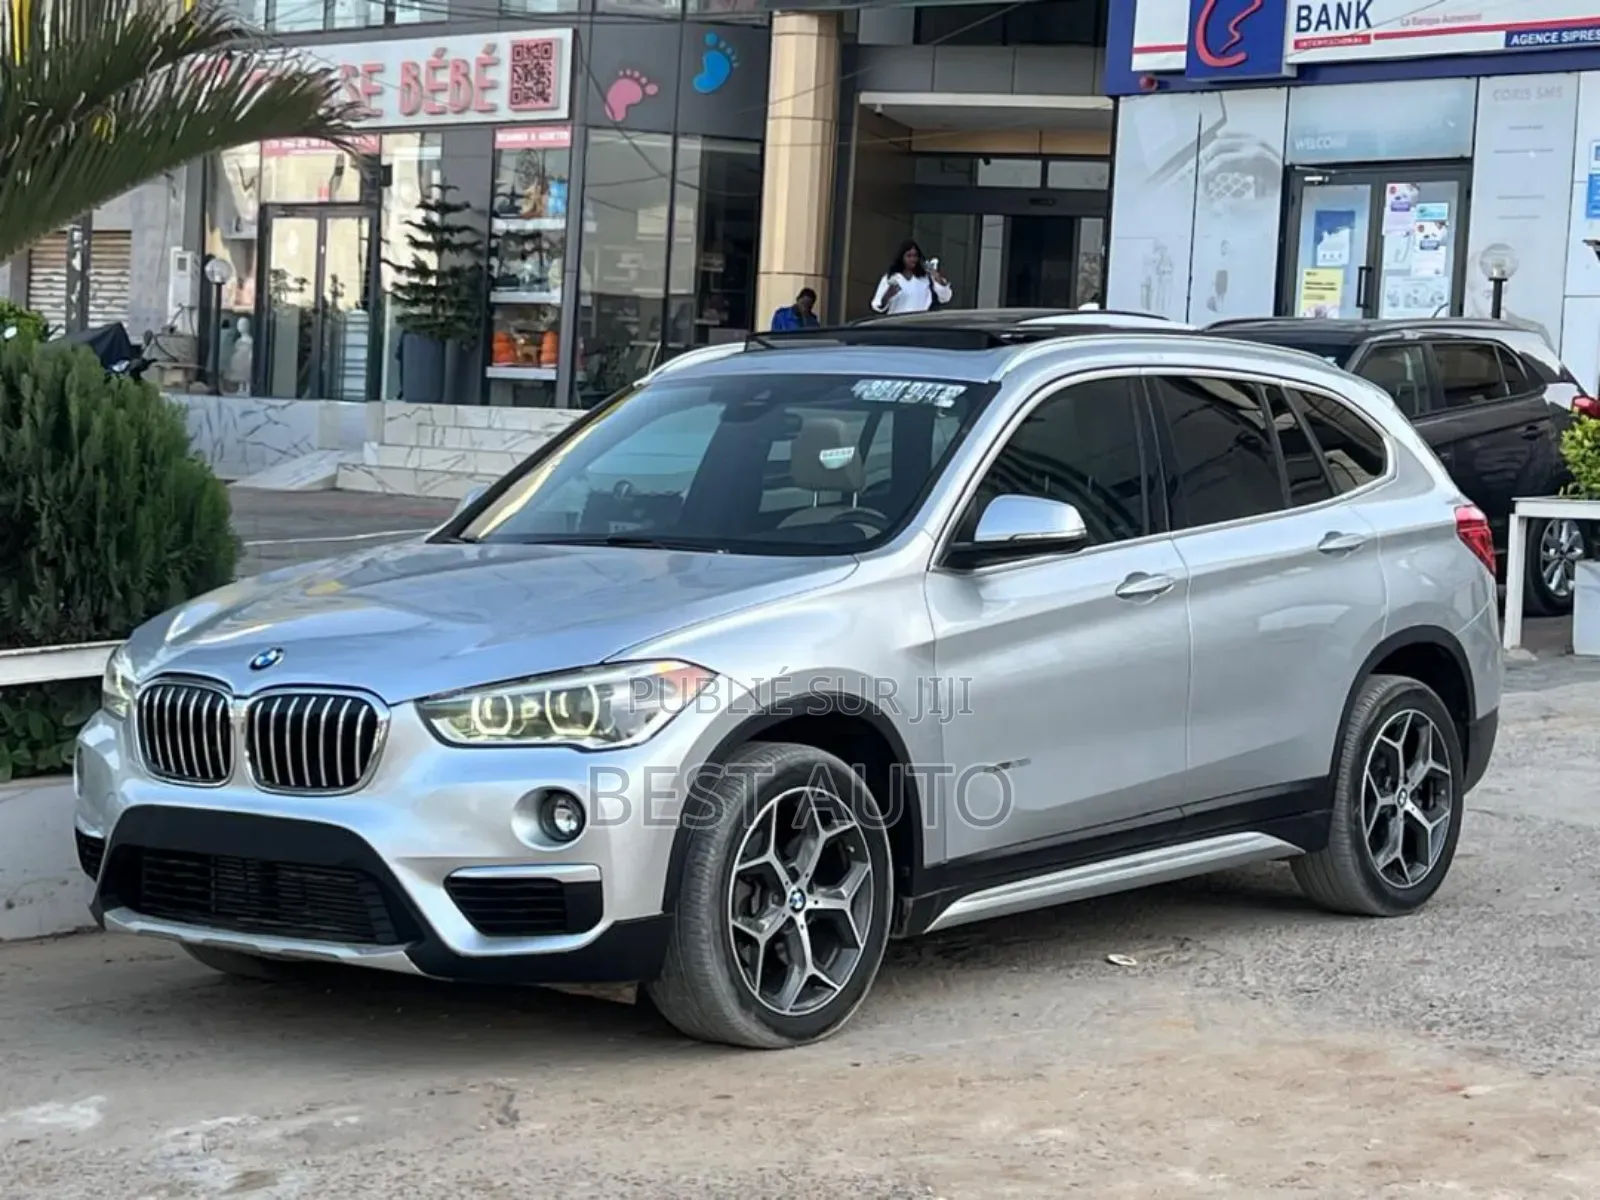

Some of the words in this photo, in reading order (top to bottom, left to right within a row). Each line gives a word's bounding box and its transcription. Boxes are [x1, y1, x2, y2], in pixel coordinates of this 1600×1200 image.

[1296, 0, 1373, 32] BANK
[1510, 31, 1559, 46] AGENCE
[399, 43, 499, 117] BÉBÉ
